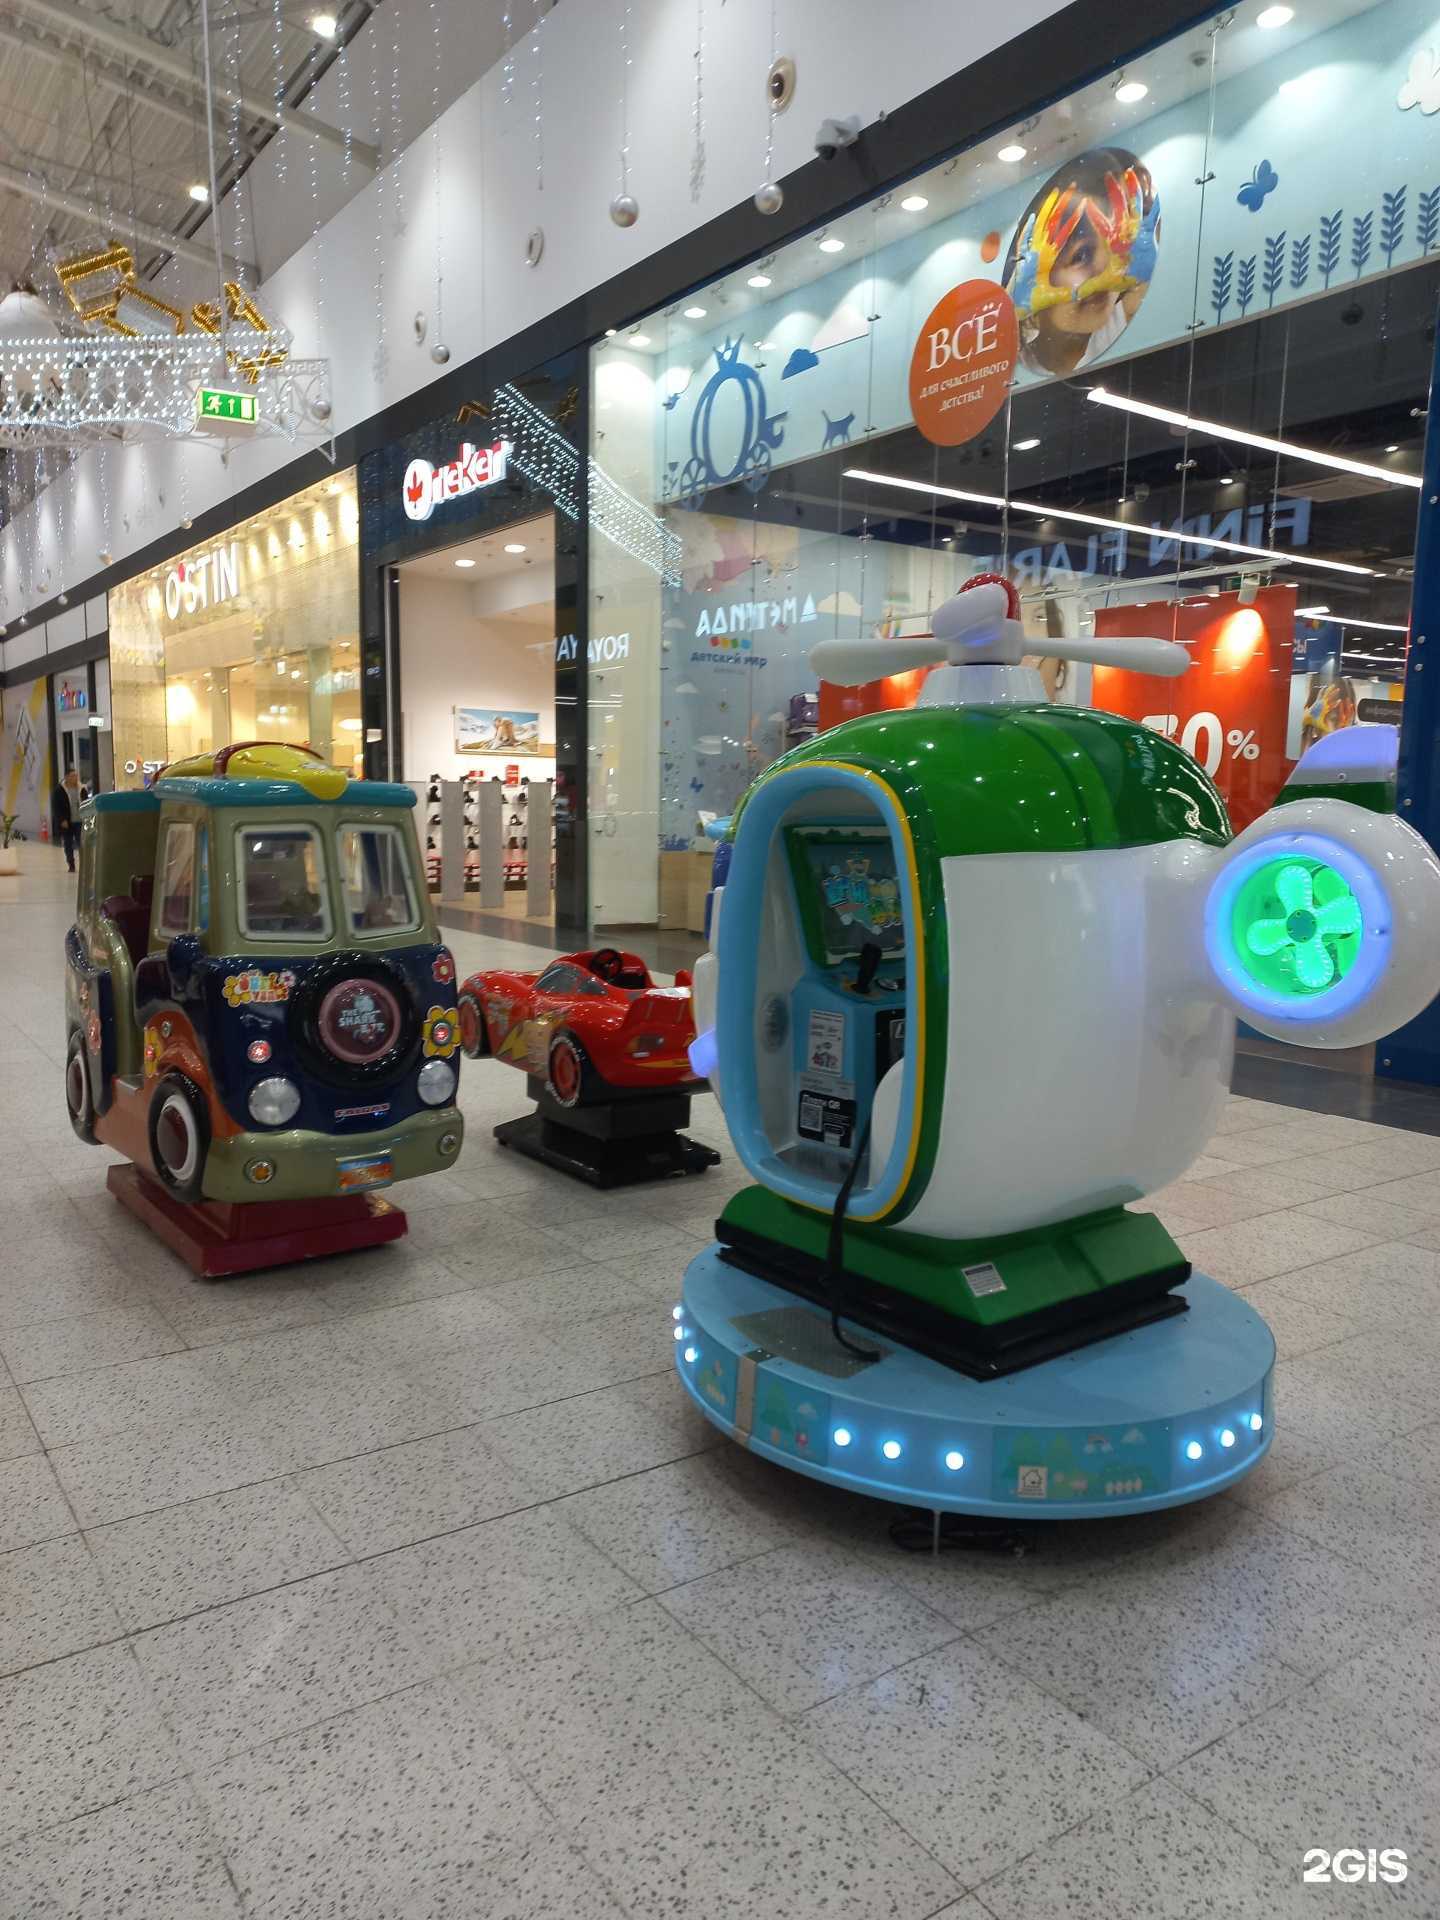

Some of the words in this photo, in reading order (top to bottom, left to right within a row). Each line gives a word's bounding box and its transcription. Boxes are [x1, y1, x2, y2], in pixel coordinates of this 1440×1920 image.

[926, 302, 1003, 373] ВСЁ
[919, 382, 940, 399] для
[940, 359, 1009, 391] счастливого
[938, 384, 985, 413] детства!
